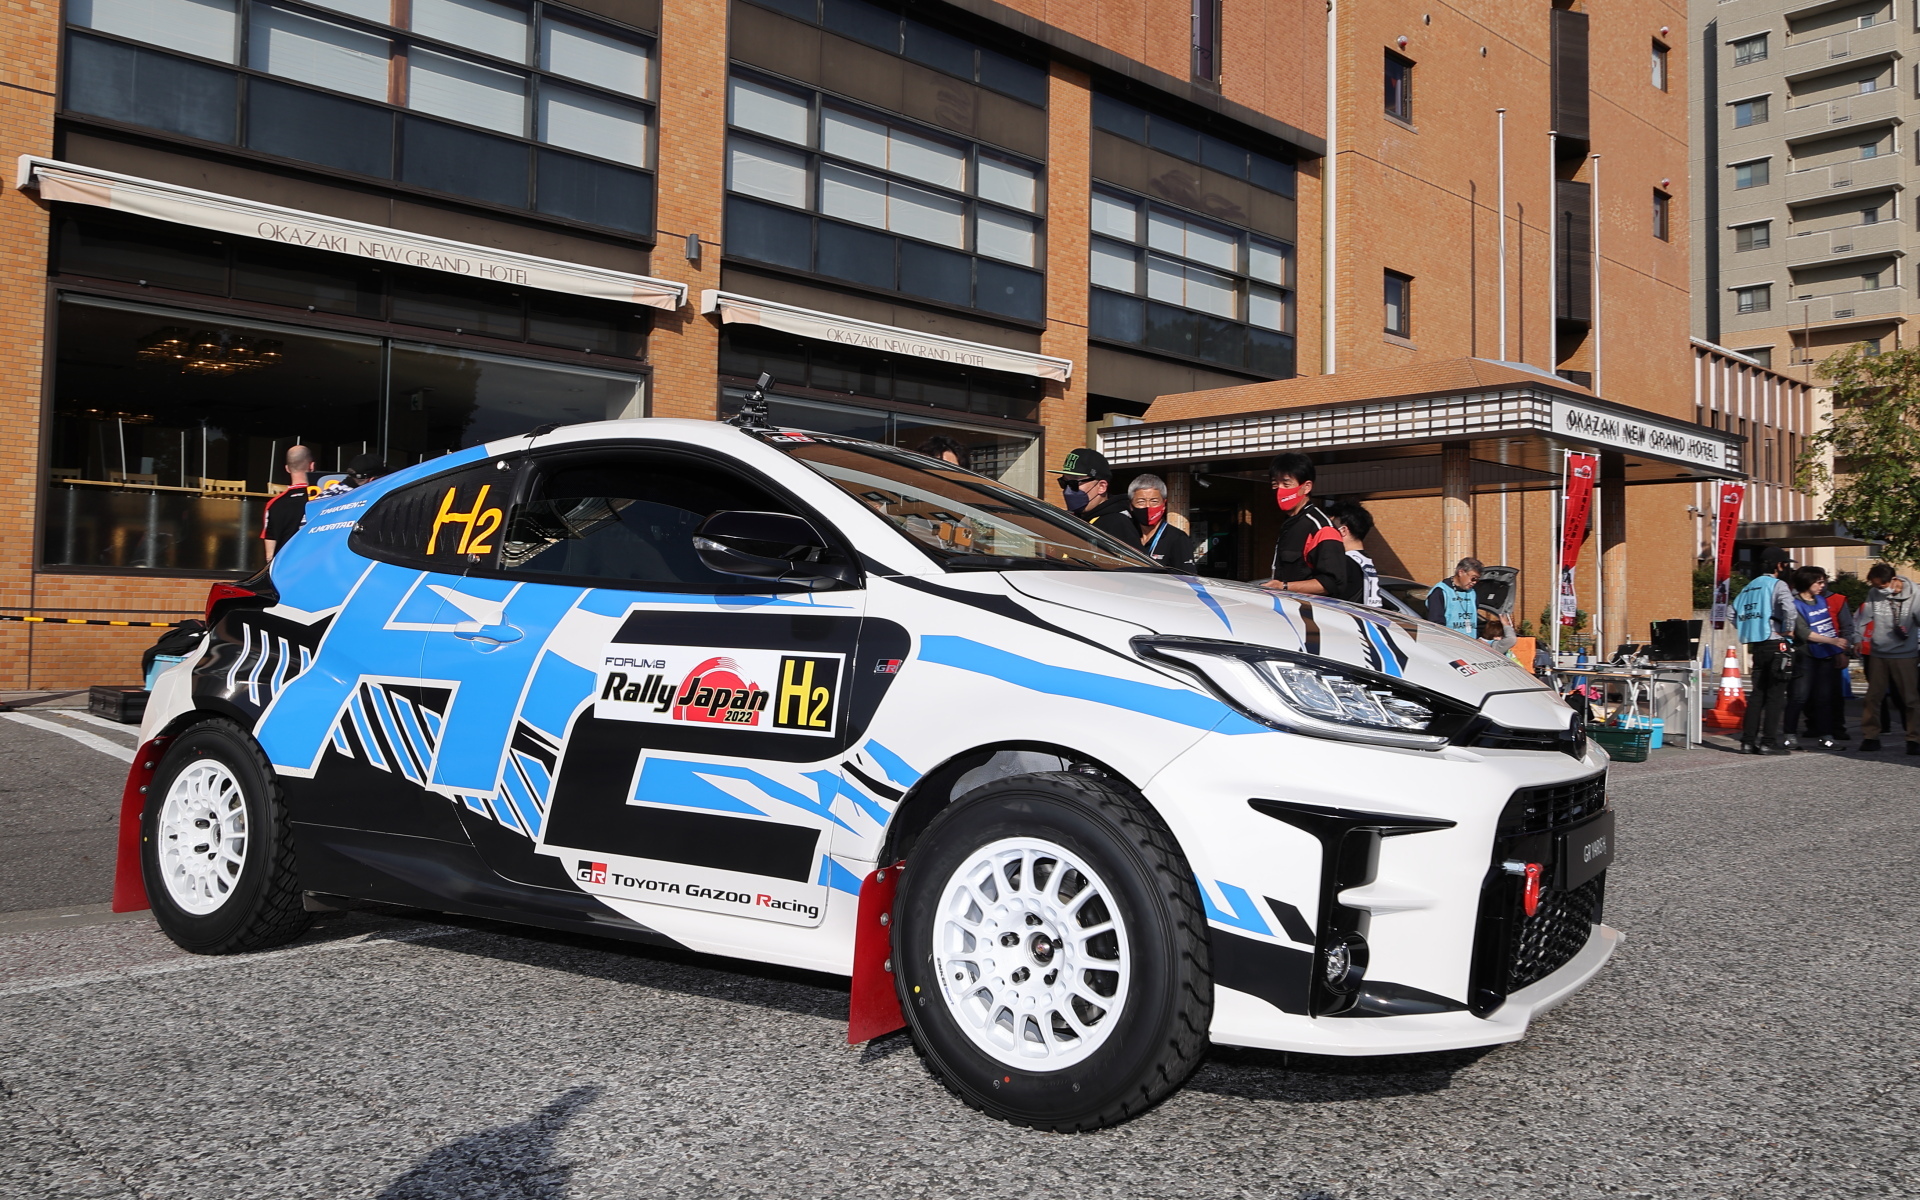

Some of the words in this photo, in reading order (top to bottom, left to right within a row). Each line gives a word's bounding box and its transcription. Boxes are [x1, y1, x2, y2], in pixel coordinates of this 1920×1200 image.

[257, 221, 347, 252] OKAZAKI
[358, 240, 402, 262] NEW
[405, 249, 470, 275] GRAND
[479, 262, 532, 286] HOTEL
[826, 327, 879, 348] OKAZAKI
[884, 339, 910, 354] NEW
[911, 344, 950, 361] GRAND
[1567, 409, 1620, 438] OKAZAKI
[1624, 423, 1646, 445] NEW
[1650, 429, 1685, 453] GRAND
[1688, 438, 1719, 461] HOTEL
[426, 484, 503, 555] H2
[605, 656, 666, 669] FORUM8
[875, 663, 901, 673] GR
[600, 671, 678, 713] Rally
[677, 676, 770, 717] Japan
[724, 710, 753, 723] 2022
[778, 659, 829, 727] H2
[577, 866, 607, 885] GR
[612, 873, 681, 894] TOYOTA
[685, 884, 751, 904] GAZOO
[756, 894, 819, 919] Racing
